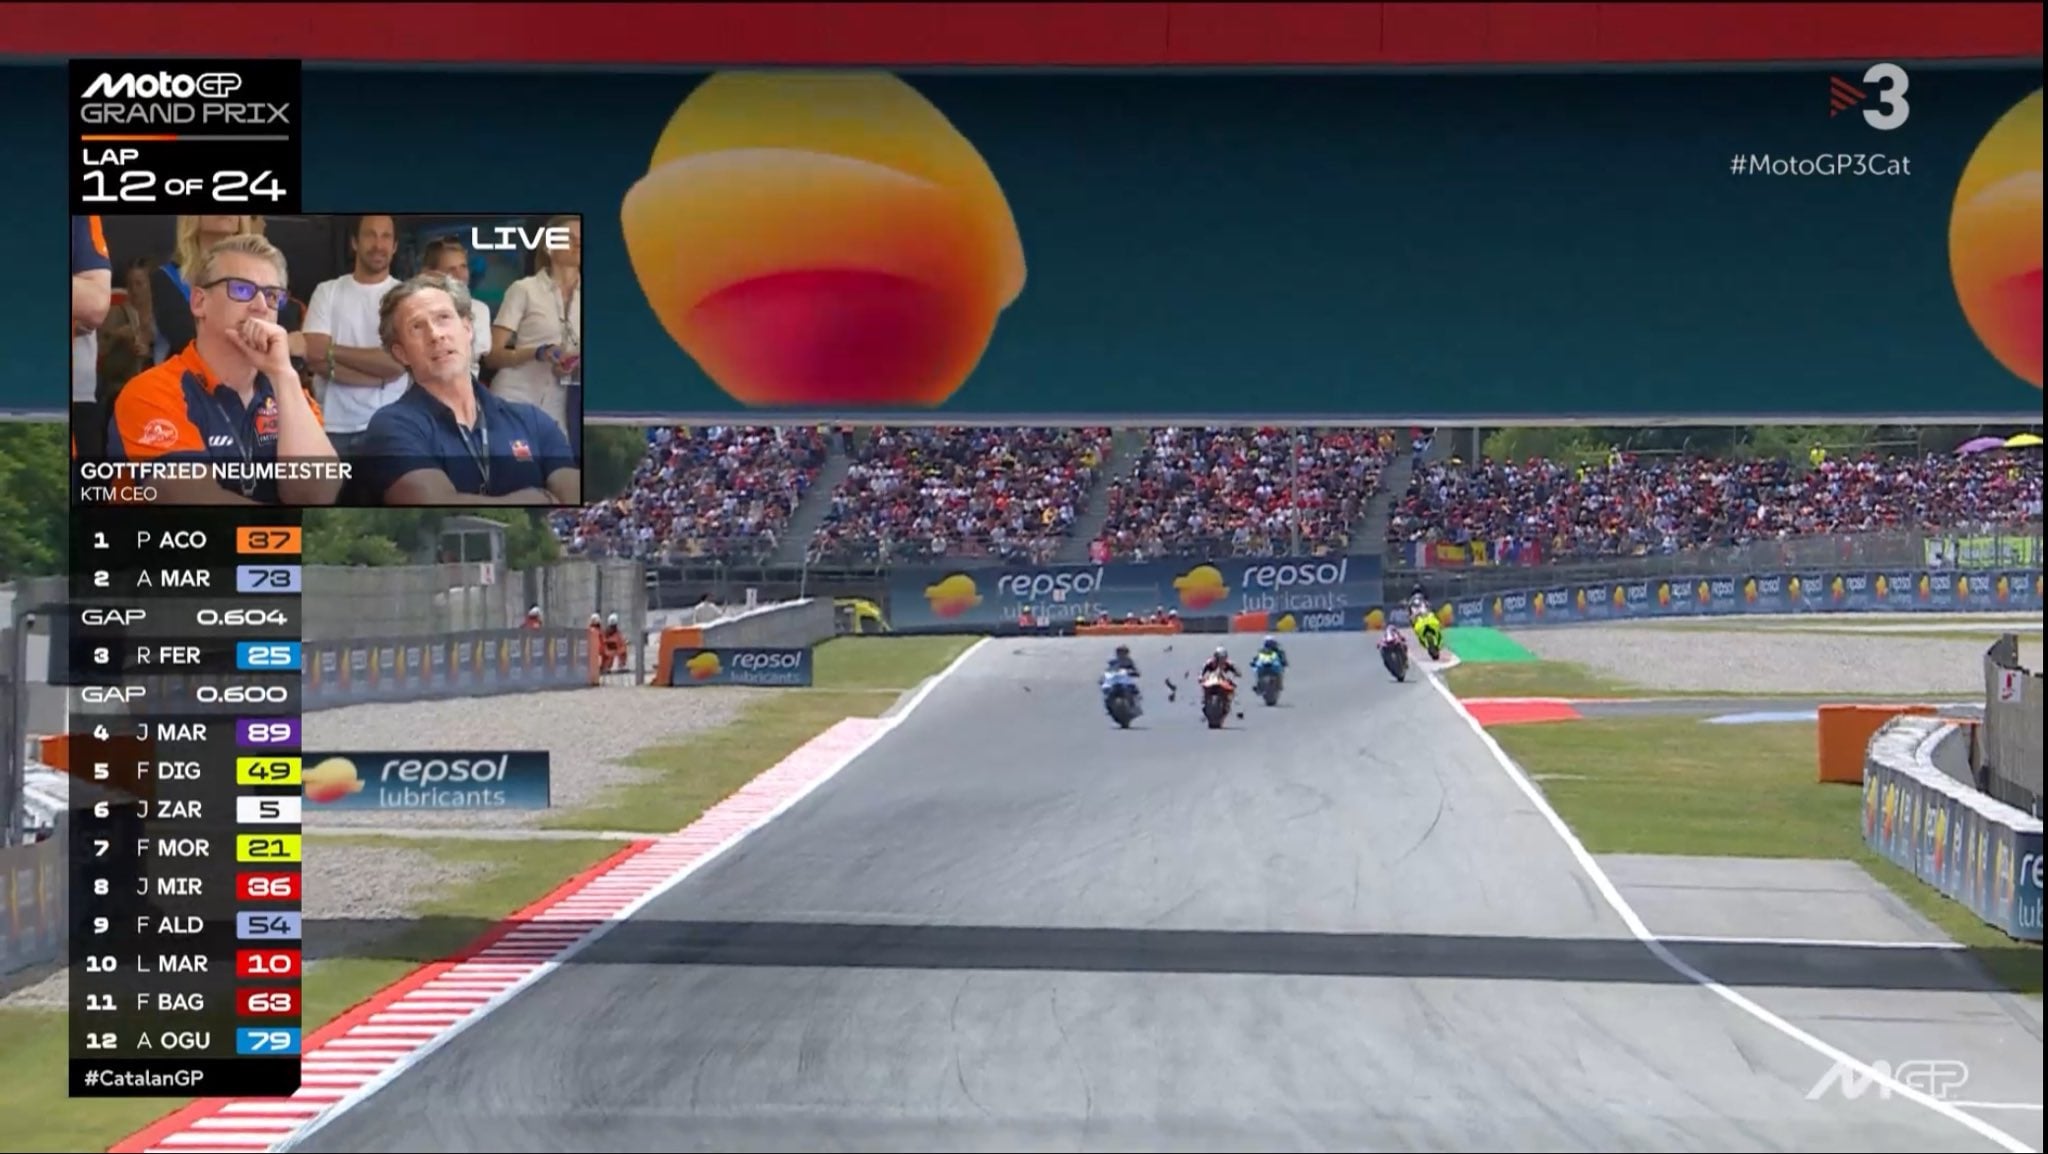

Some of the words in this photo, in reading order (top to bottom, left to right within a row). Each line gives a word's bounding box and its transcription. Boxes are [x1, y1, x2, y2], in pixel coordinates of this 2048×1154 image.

[997, 567, 1104, 601] repsol
[1242, 558, 1348, 591] repsol
[1303, 612, 1345, 628] repsol
[732, 651, 802, 671] repsol
[380, 754, 508, 787] repsol
[379, 786, 506, 807] lubricants
